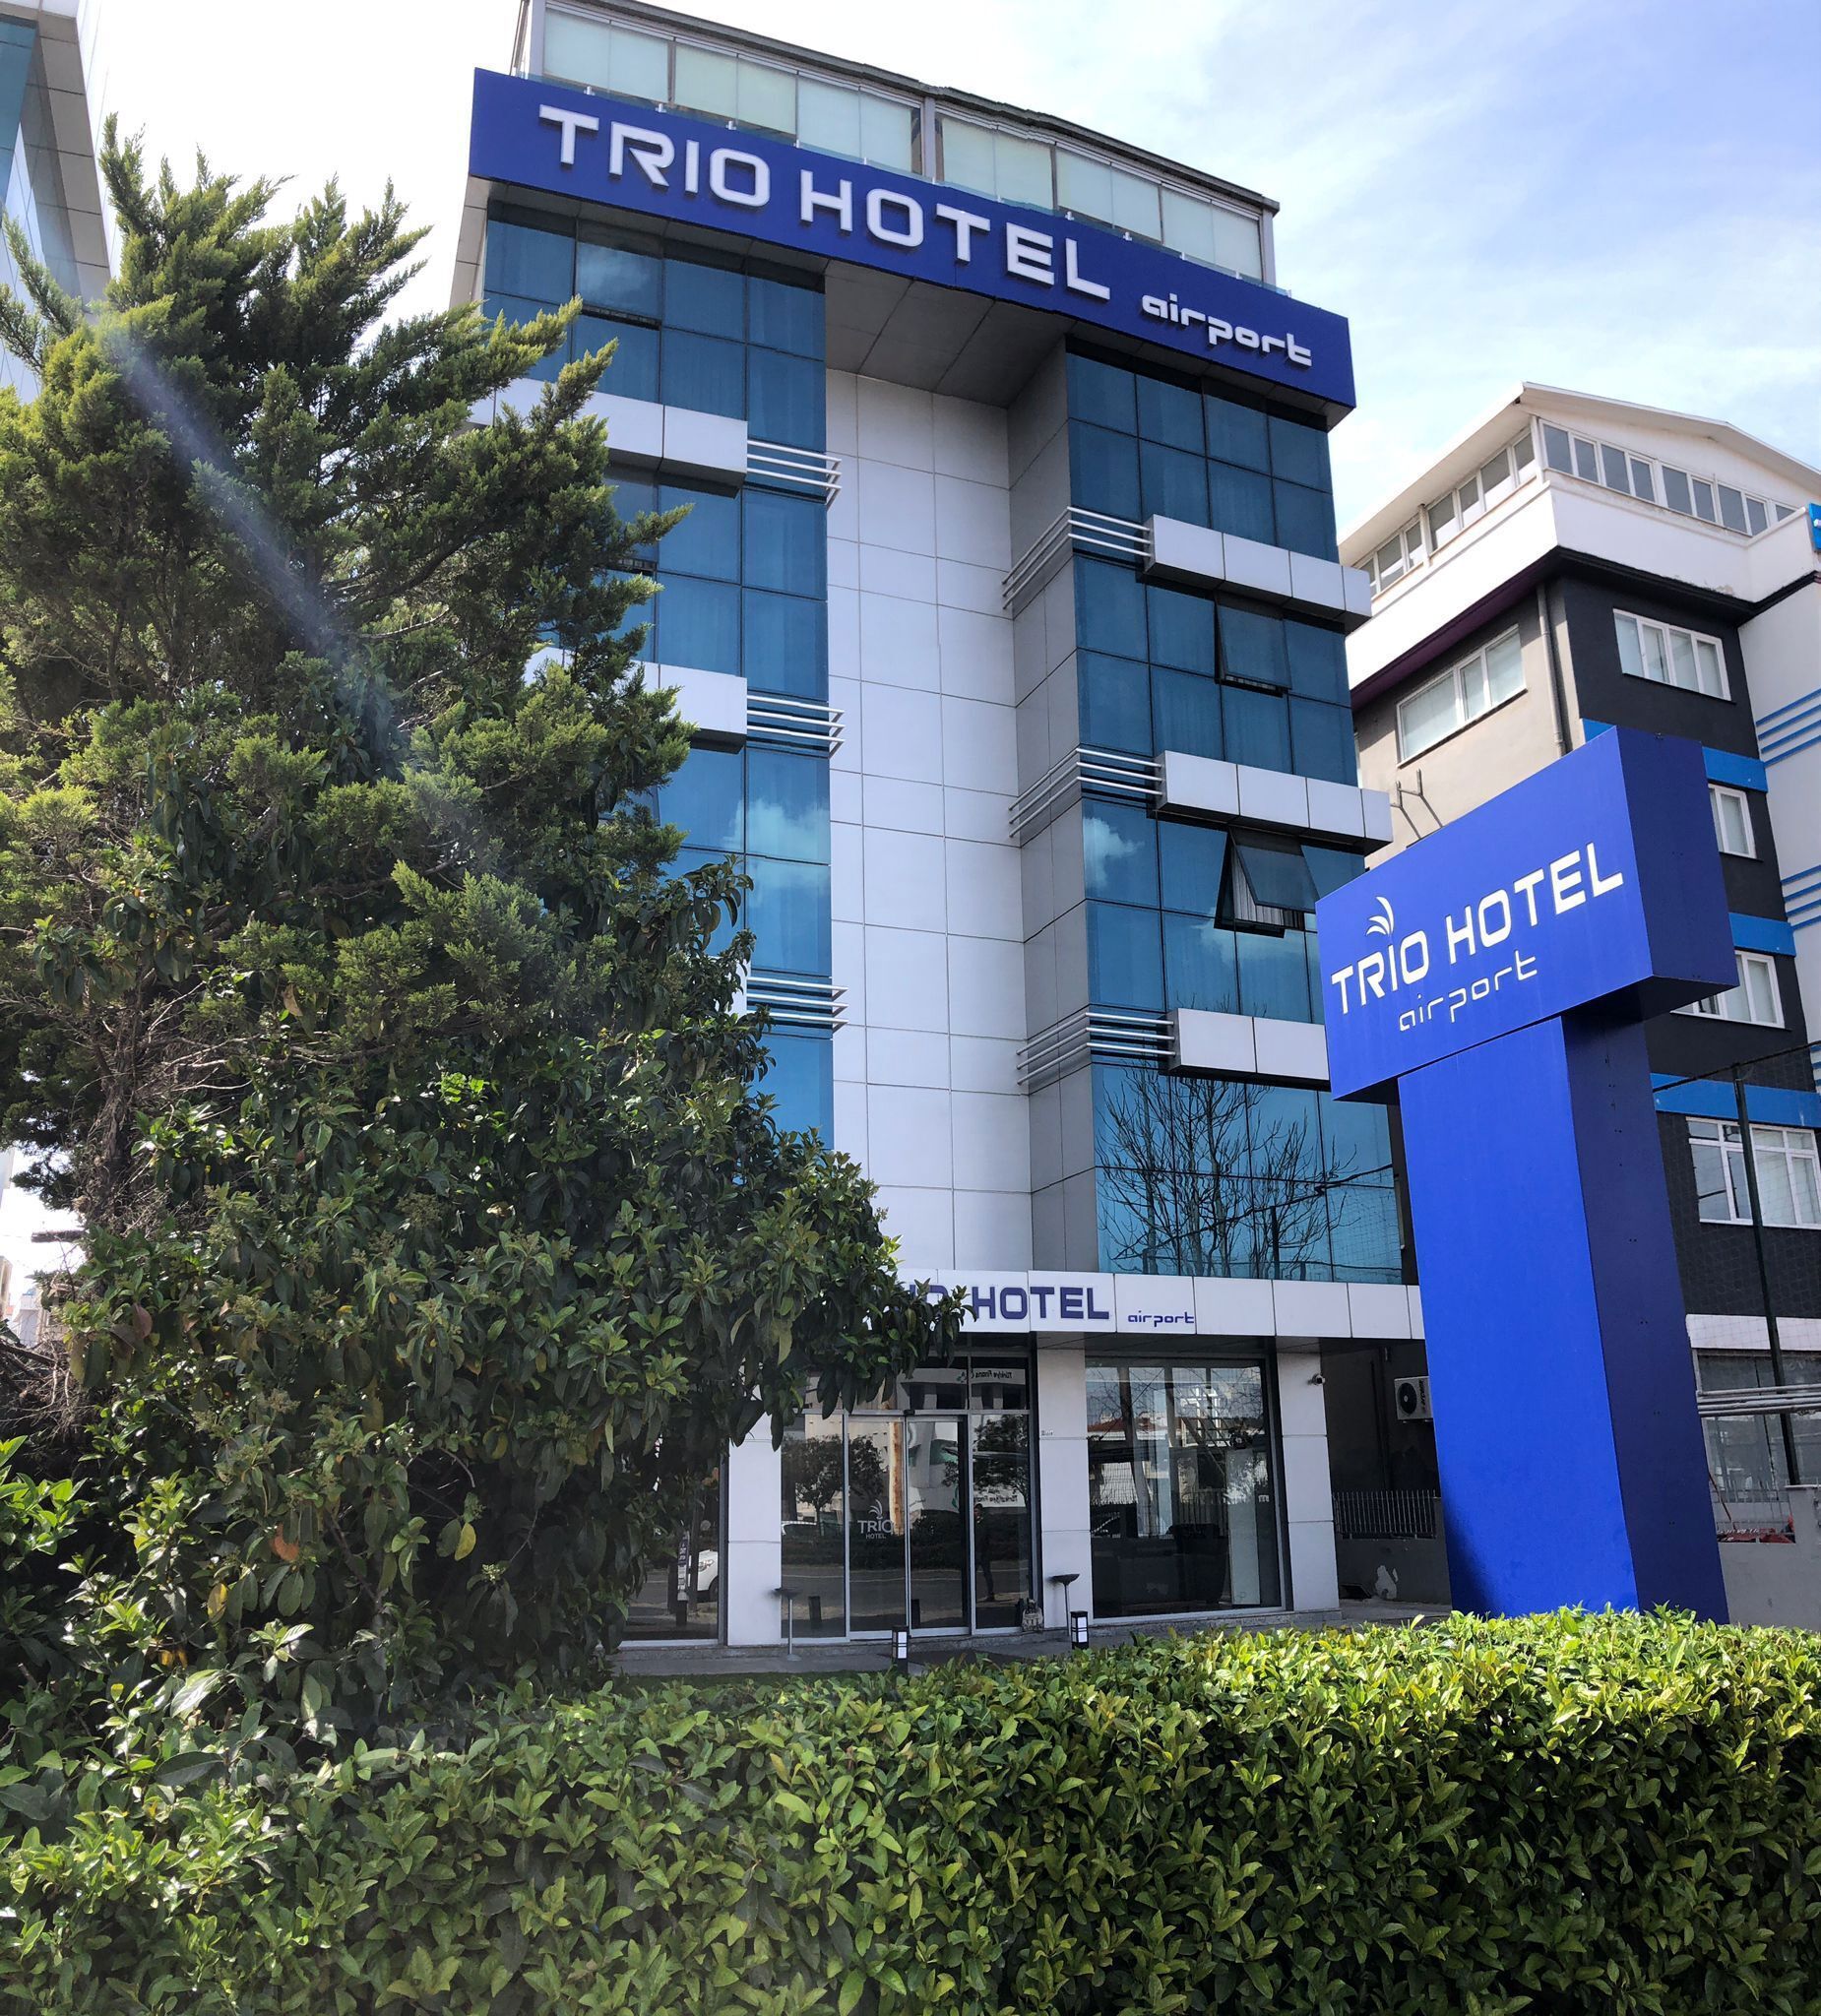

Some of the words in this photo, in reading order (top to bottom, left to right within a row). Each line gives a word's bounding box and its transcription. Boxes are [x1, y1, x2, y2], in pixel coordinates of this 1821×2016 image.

[538, 104, 770, 207] TRIO
[800, 169, 1110, 300] HOTEL
[1142, 292, 1313, 366] airport
[1331, 930, 1430, 1015] TRIO
[1445, 842, 1624, 965] HOTEL
[1399, 950, 1538, 1032] airport
[971, 1286, 1110, 1320] HOTEL
[1127, 1310, 1196, 1328] airport
[857, 1519, 894, 1534] TRIO
